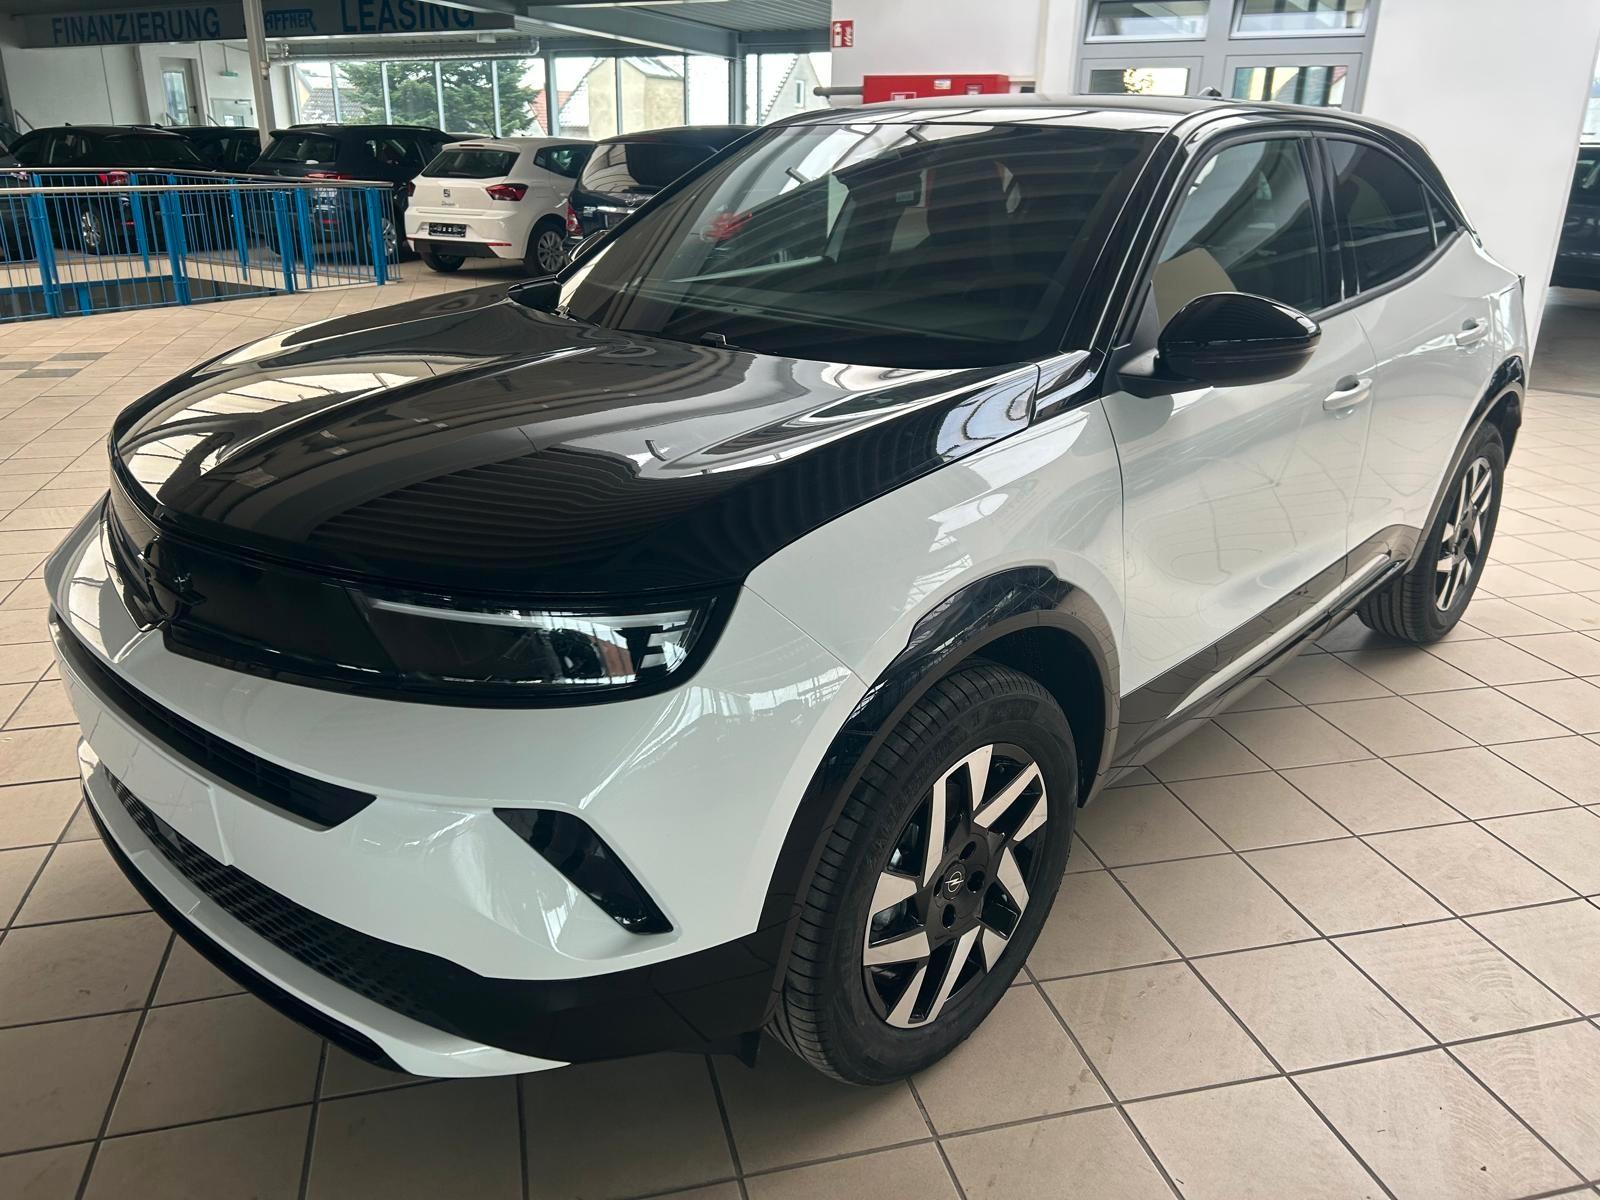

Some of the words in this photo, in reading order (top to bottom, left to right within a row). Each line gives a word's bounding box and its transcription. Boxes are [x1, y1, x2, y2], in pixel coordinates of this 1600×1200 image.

[51, 7, 221, 45] FINANZIERUNG
[264, 9, 317, 33] AFFNER
[340, 0, 475, 32] LEASING
